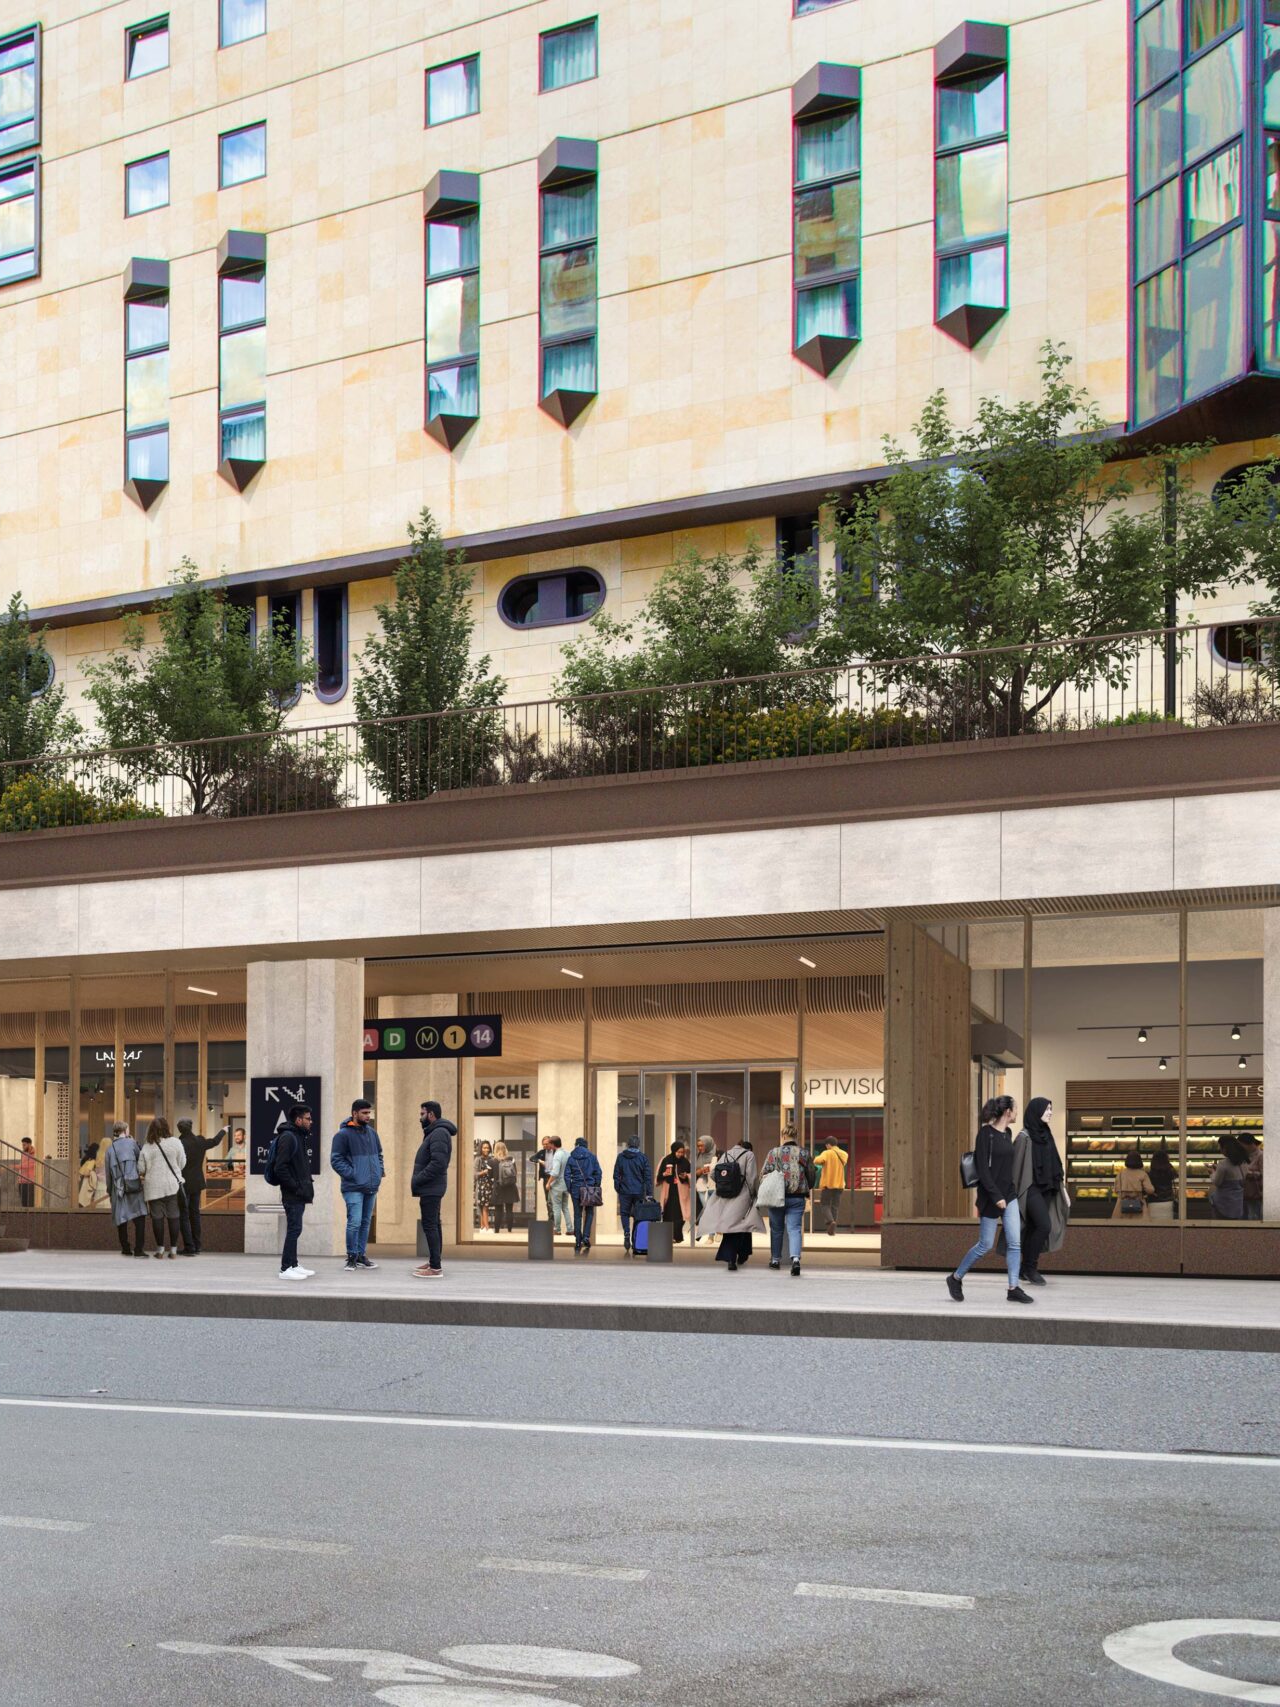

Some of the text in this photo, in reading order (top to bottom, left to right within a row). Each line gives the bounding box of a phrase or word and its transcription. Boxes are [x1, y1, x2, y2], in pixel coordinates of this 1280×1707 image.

[389, 1032, 401, 1047] D
[421, 1031, 434, 1045] M
[473, 1028, 492, 1045] 14
[1187, 1085, 1264, 1098] FRUITS
